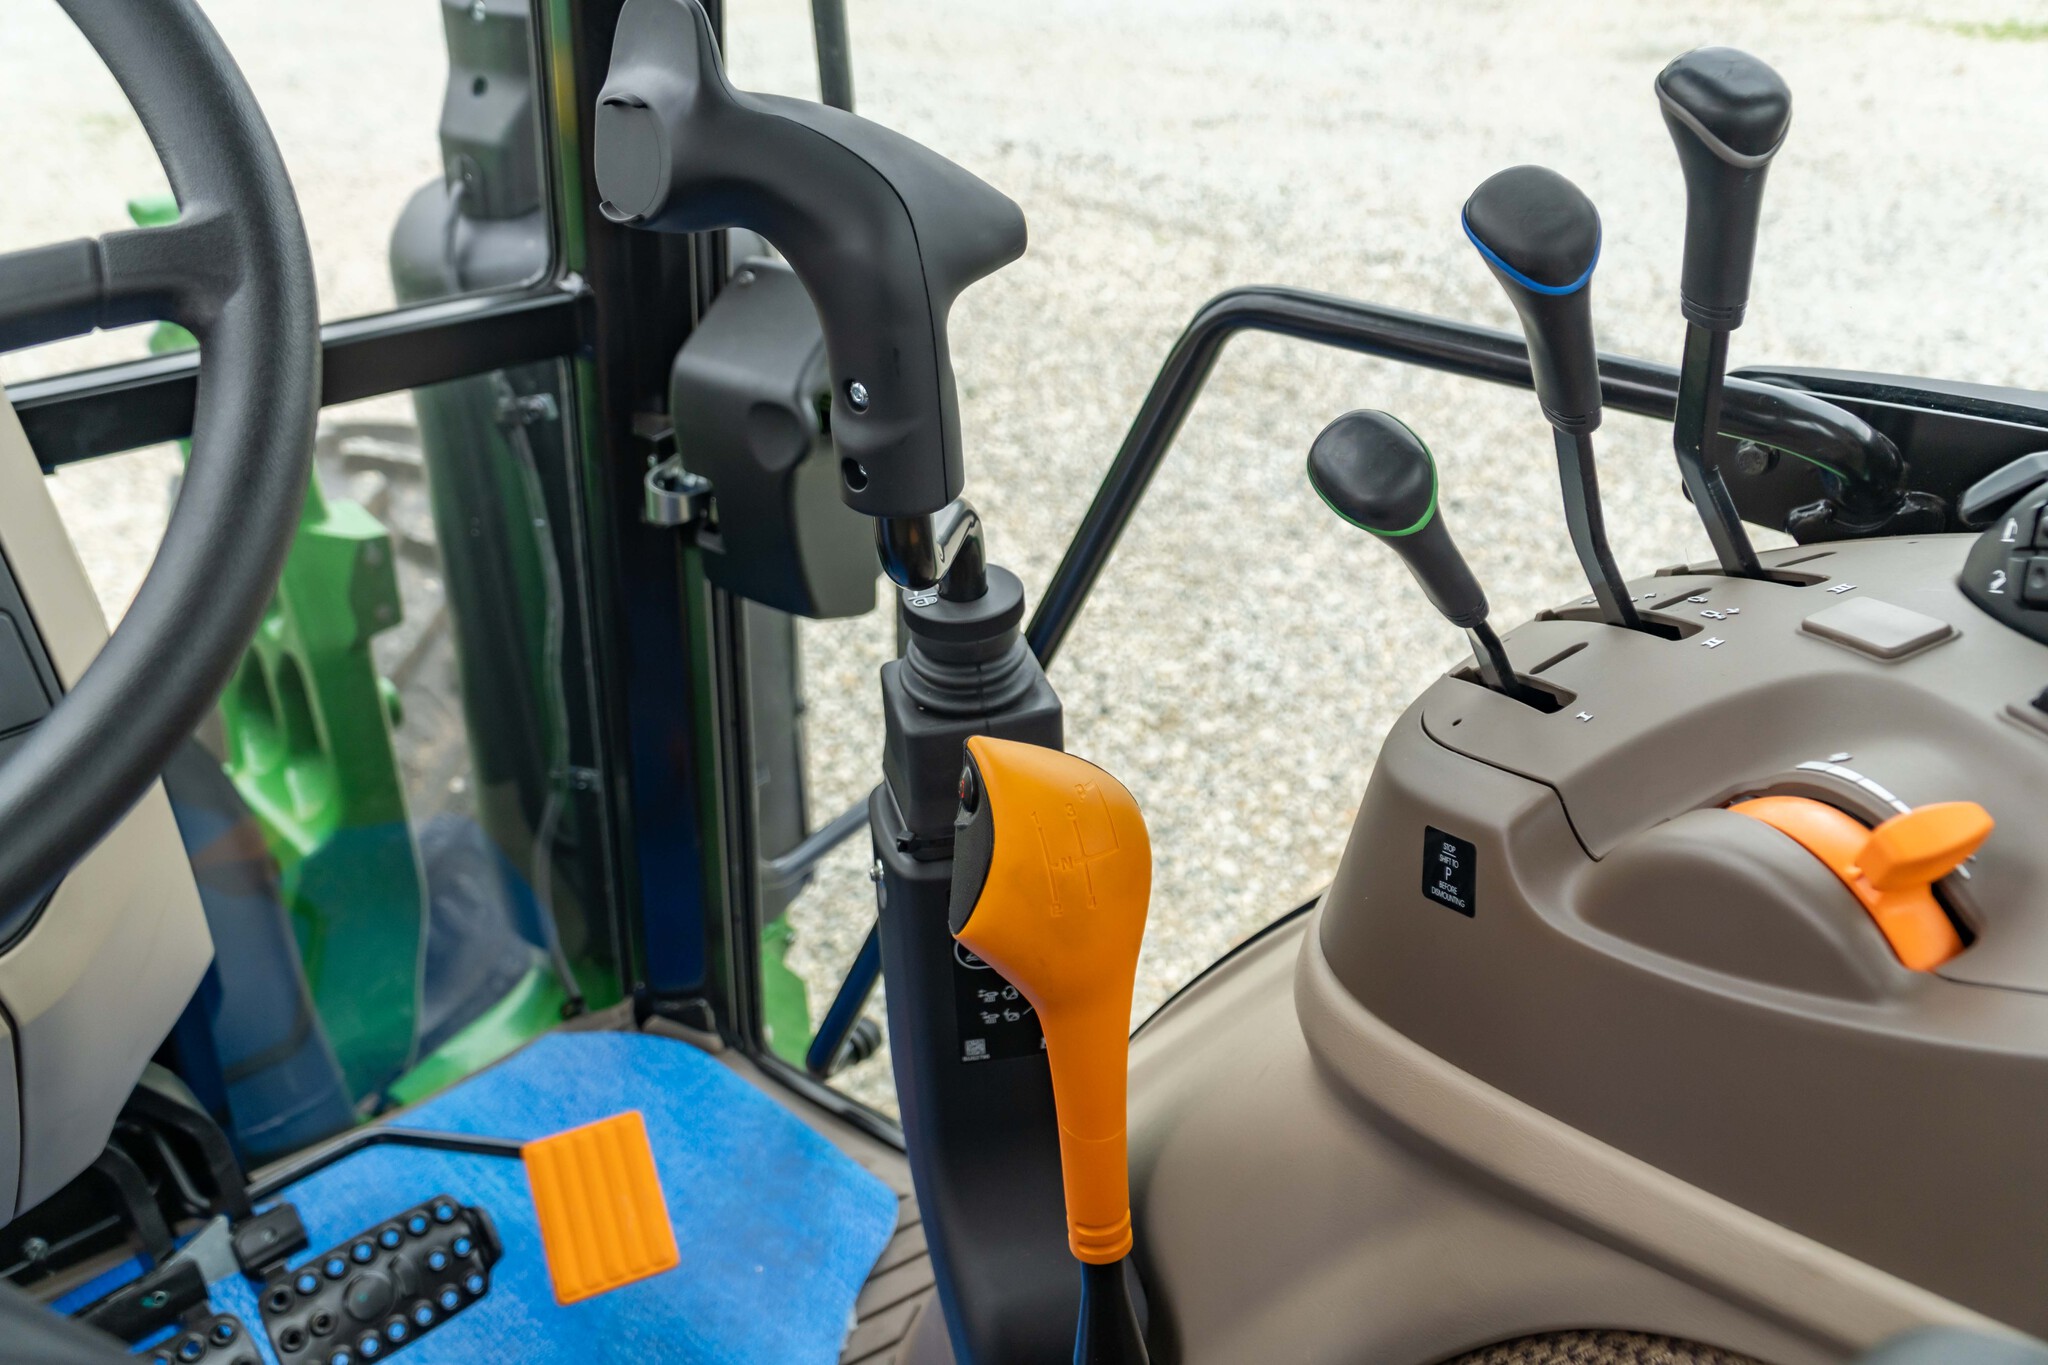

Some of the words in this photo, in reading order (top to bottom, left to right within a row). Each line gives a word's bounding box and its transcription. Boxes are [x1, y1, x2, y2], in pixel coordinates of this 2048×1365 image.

[1826, 583, 1858, 595] III
[1987, 569, 2007, 594] 2
[1701, 637, 1726, 649] II
[1065, 802, 1077, 818] 3
[1031, 811, 1040, 826] 1
[1443, 842, 1457, 853] STOP
[1060, 856, 1074, 871] N
[1439, 854, 1452, 866] SHIFT
[1452, 858, 1460, 869] TO
[1445, 866, 1453, 881] P
[1439, 880, 1458, 896] BEFORE
[1431, 886, 1466, 908] DISMOUNTING
[1051, 902, 1063, 917] 2
